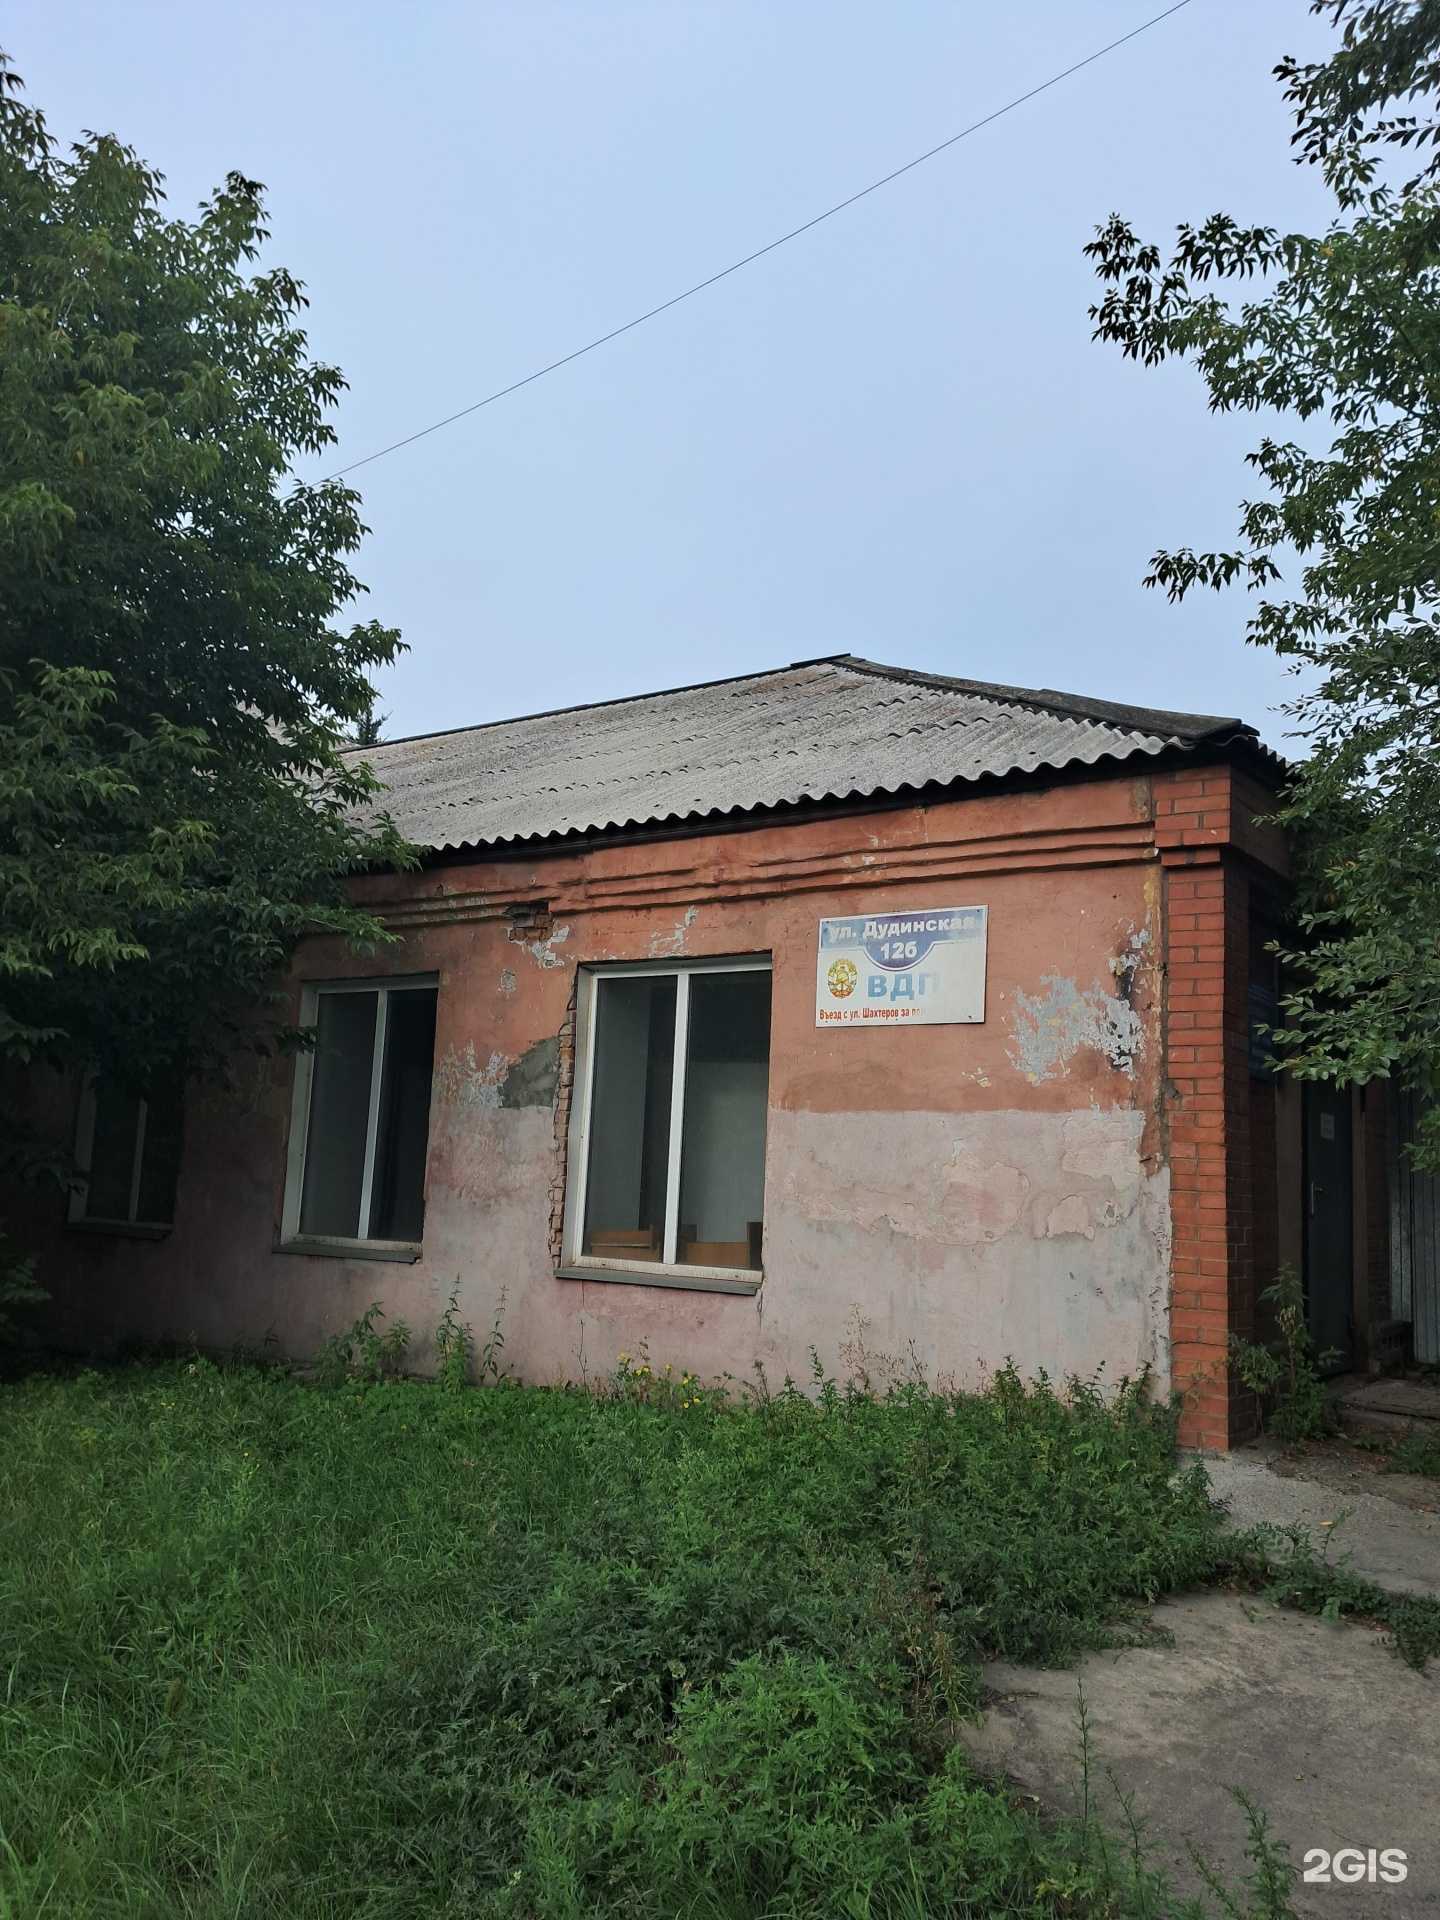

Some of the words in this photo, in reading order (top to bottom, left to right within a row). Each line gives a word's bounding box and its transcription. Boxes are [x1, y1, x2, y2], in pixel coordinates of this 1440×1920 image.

[829, 926, 856, 943] ул.
[863, 916, 976, 939] Дудинская
[819, 1009, 842, 1020] Въезд
[843, 1011, 848, 1019] с
[850, 1009, 861, 1021] ул.
[862, 1007, 899, 1020] Шахтеров
[900, 1007, 910, 1017] за
